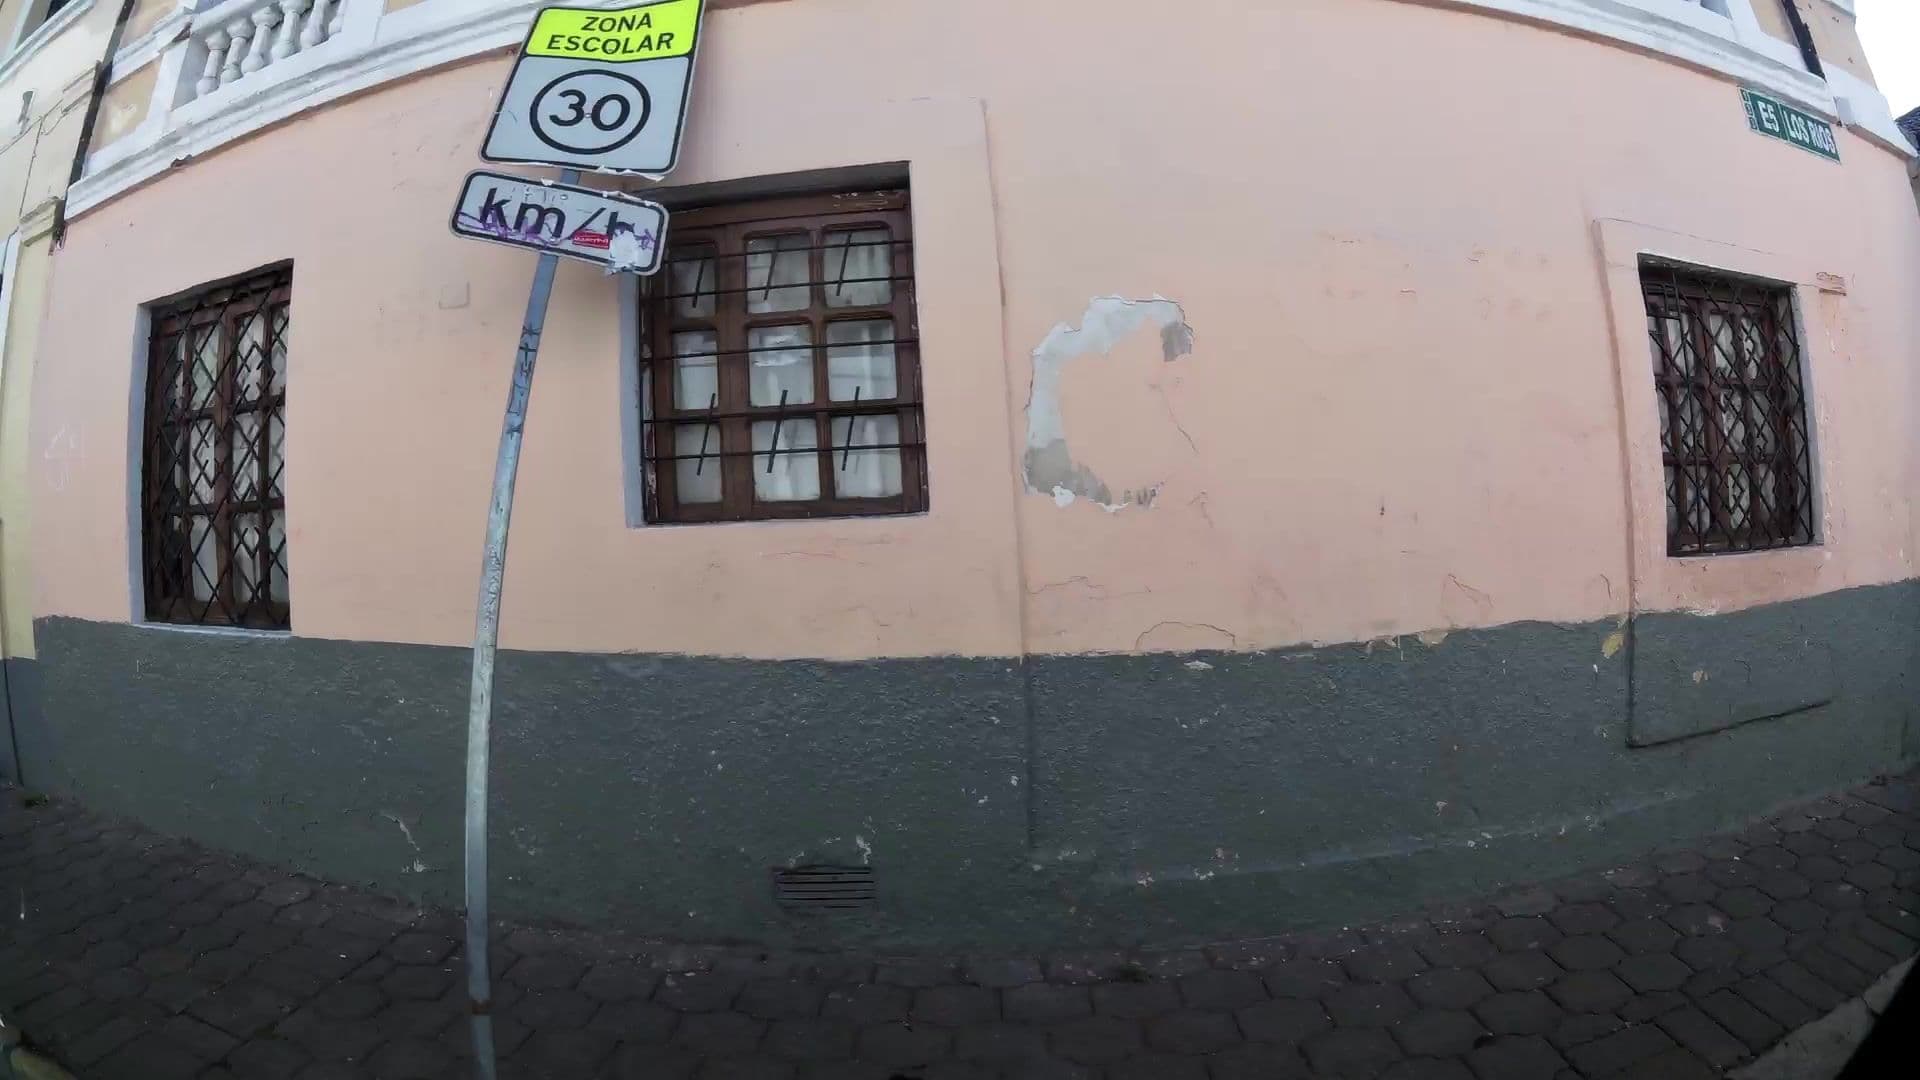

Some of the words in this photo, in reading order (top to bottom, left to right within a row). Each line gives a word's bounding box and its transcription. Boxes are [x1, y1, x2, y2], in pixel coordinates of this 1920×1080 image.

[581, 13, 652, 33] ZONA
[546, 33, 674, 55] ESCOLAR
[549, 89, 630, 131] 30
[1757, 101, 1779, 133] E5
[1784, 110, 1810, 144] LOS
